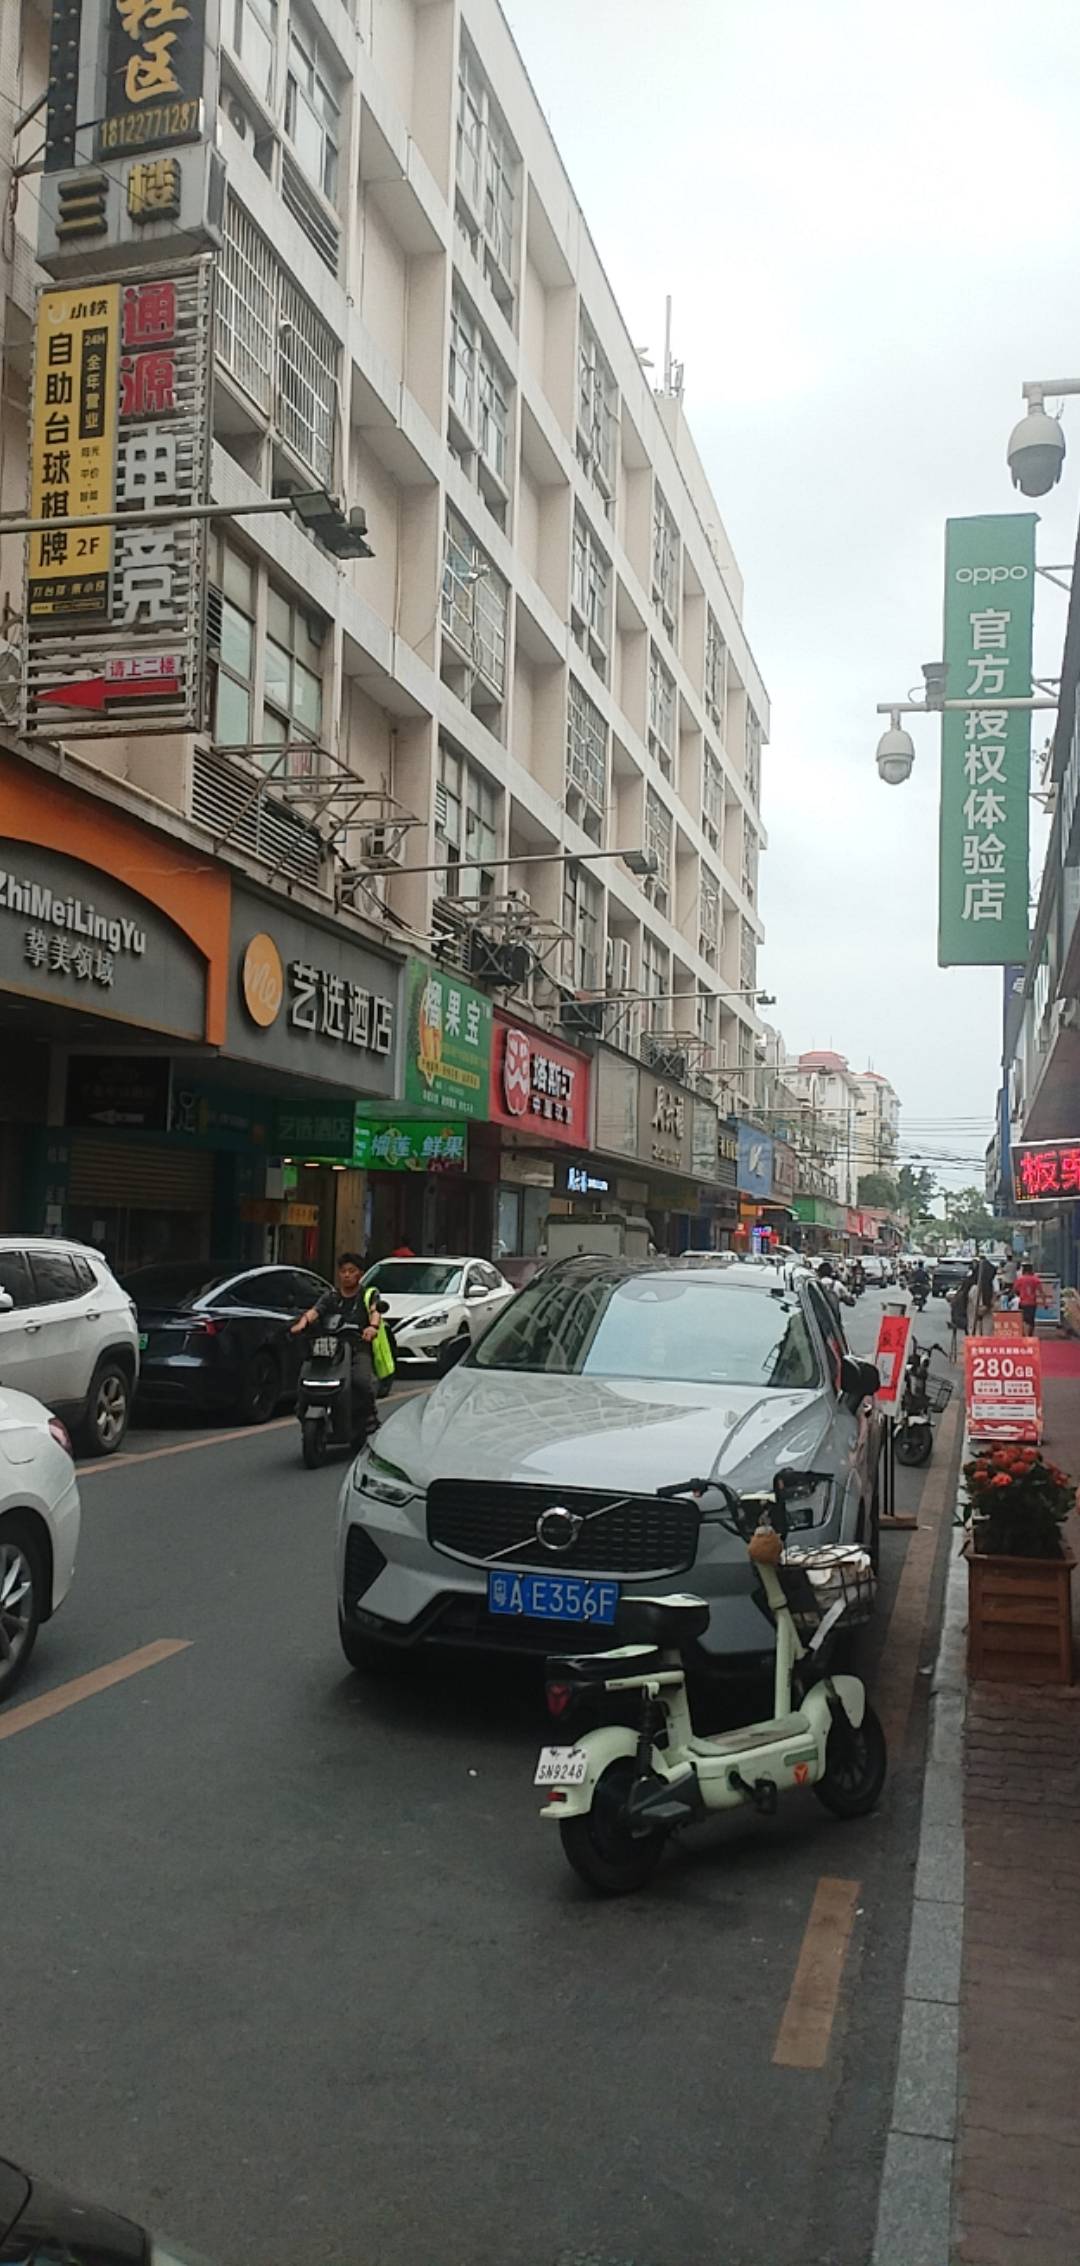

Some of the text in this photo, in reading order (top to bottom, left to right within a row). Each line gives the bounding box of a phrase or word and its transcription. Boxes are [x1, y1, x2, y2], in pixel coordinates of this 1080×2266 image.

[101, 100, 199, 147] 18122771287
[56, 156, 181, 240] 三楼
[39, 332, 73, 567] 自助台球棋牌
[76, 536, 100, 556] 2F
[109, 656, 176, 678] 请上二楼
[961, 607, 1012, 921] 官方授权体验店
[290, 960, 394, 1056] 艺选酒店
